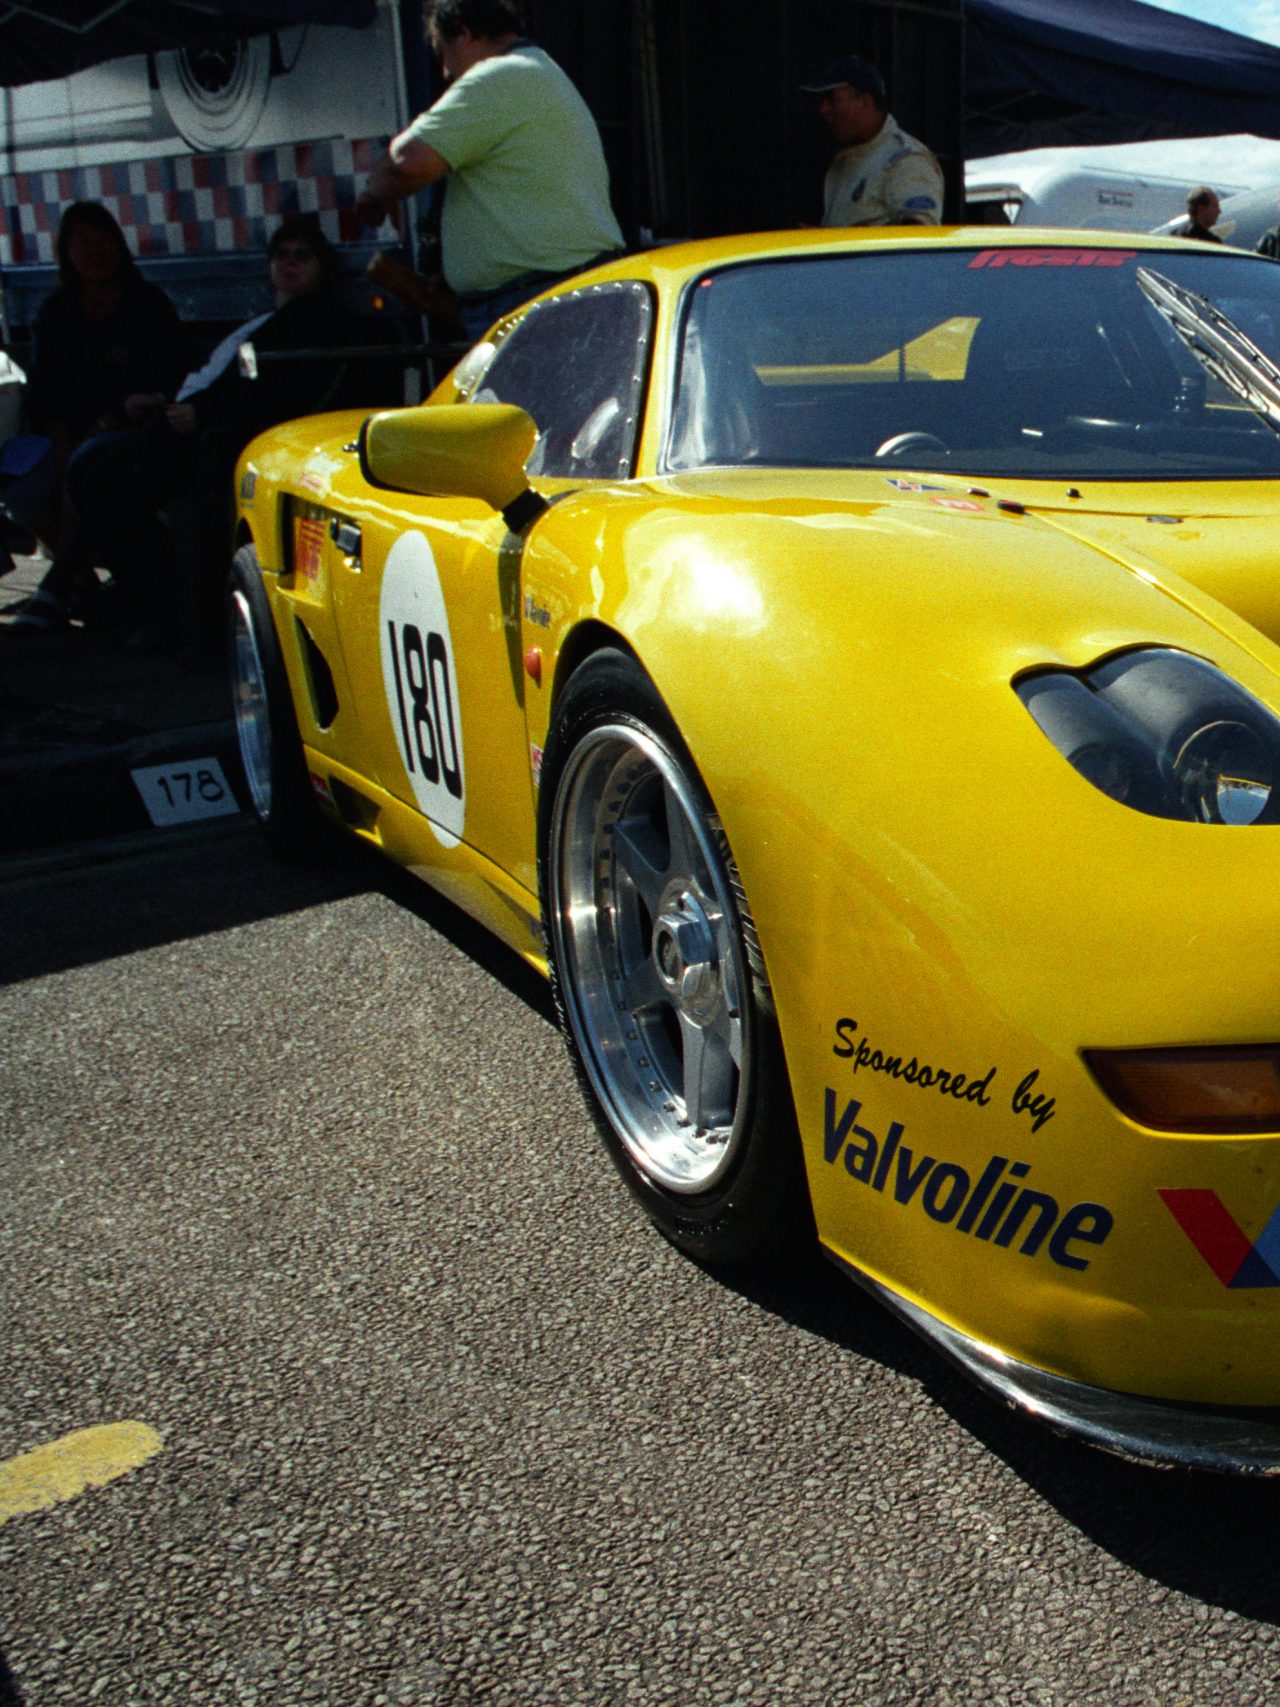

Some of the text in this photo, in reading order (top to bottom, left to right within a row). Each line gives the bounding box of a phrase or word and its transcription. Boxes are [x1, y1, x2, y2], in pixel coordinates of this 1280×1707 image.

[388, 620, 463, 800] 180
[158, 770, 225, 808] 178
[832, 1017, 1056, 1134] Sponsored by
[823, 1086, 1114, 1272] Valvoline
